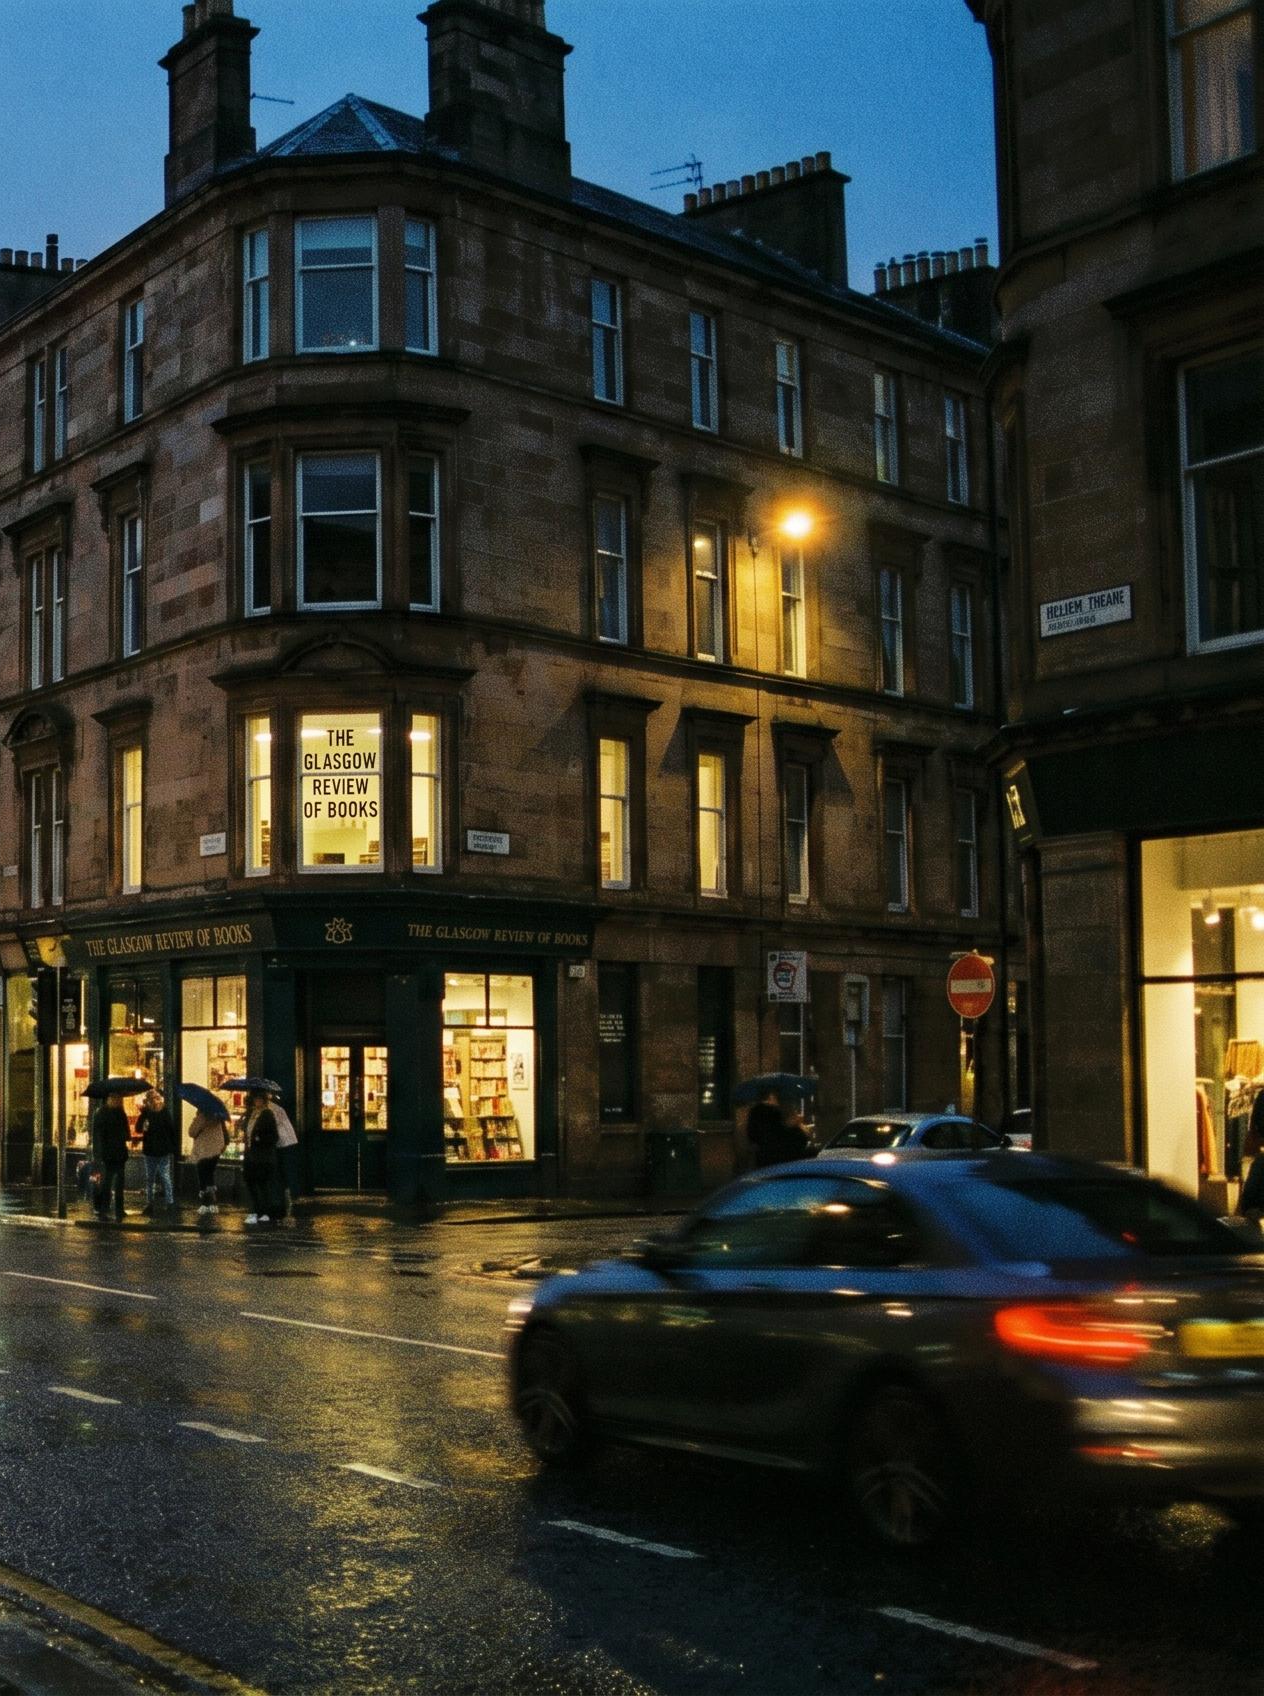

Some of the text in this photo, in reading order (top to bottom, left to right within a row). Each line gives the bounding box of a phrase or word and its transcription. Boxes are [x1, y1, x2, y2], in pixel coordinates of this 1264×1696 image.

[327, 729, 354, 747] THE
[304, 752, 377, 770] GLASGOW
[313, 778, 369, 795] REVIEW
[304, 801, 378, 818] OF BOOKS
[85, 924, 253, 957] THE GLASGOW REVIEW OF BOOKS
[407, 924, 588, 946] THE GLASGOW REVIEW OF BOOKS
